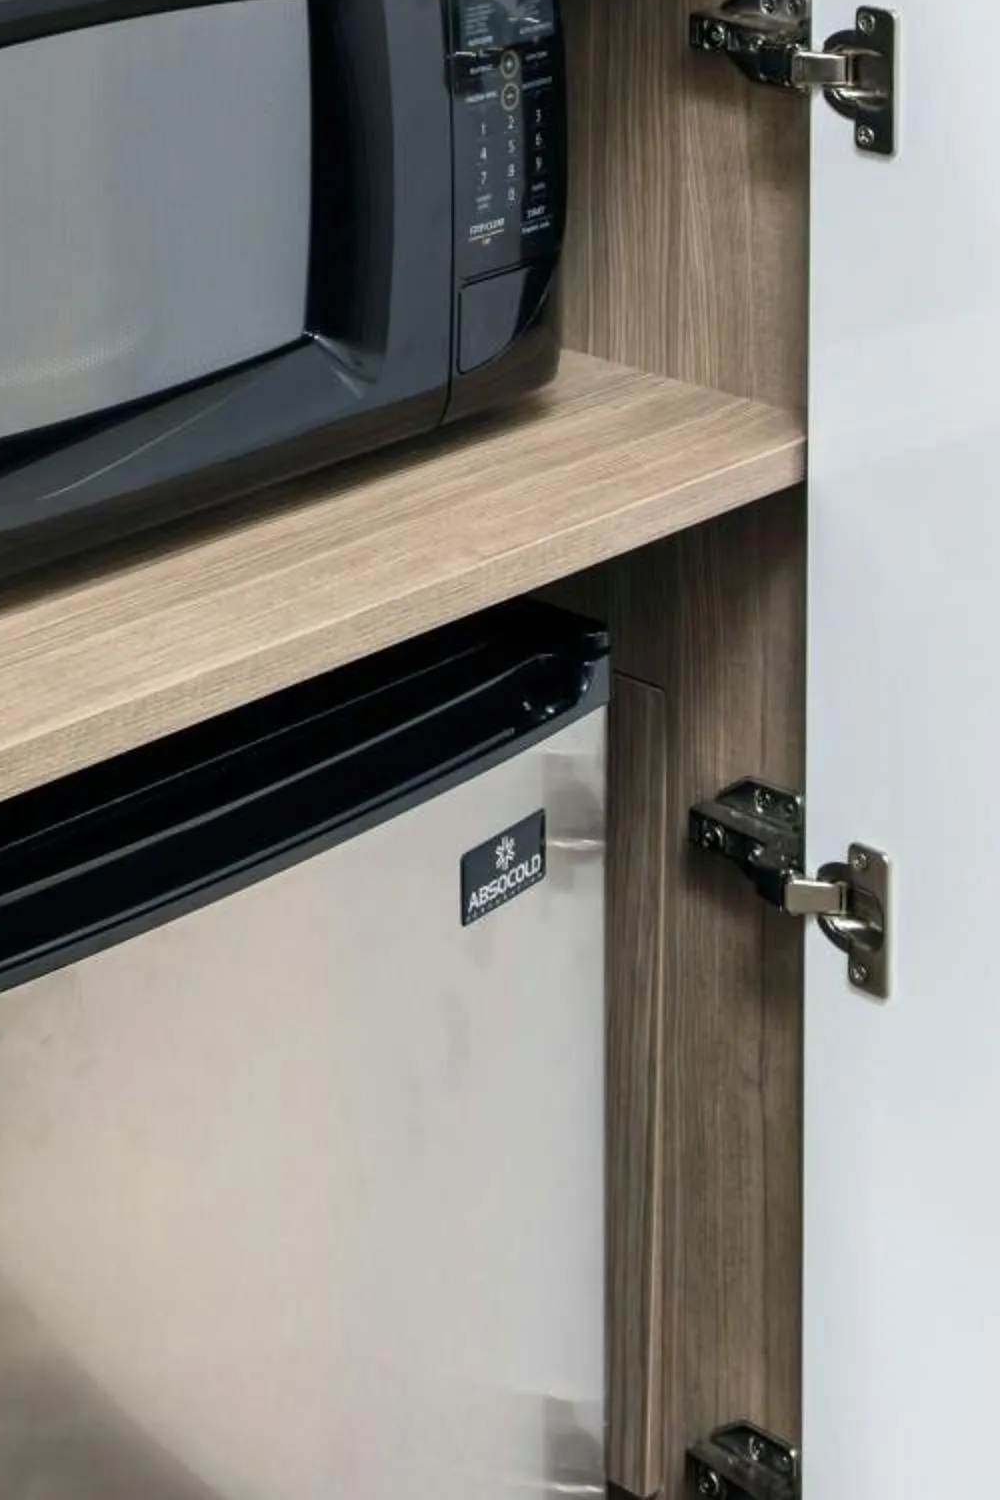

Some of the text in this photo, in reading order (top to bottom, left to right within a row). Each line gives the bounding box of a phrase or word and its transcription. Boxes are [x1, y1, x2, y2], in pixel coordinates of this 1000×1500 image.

[507, 115, 515, 129] 2
[535, 109, 542, 122] 3
[481, 123, 486, 135] 1
[479, 147, 488, 160] 4
[507, 140, 516, 154] 5
[480, 171, 487, 185] 7
[468, 853, 541, 913] ABSOCOLD
